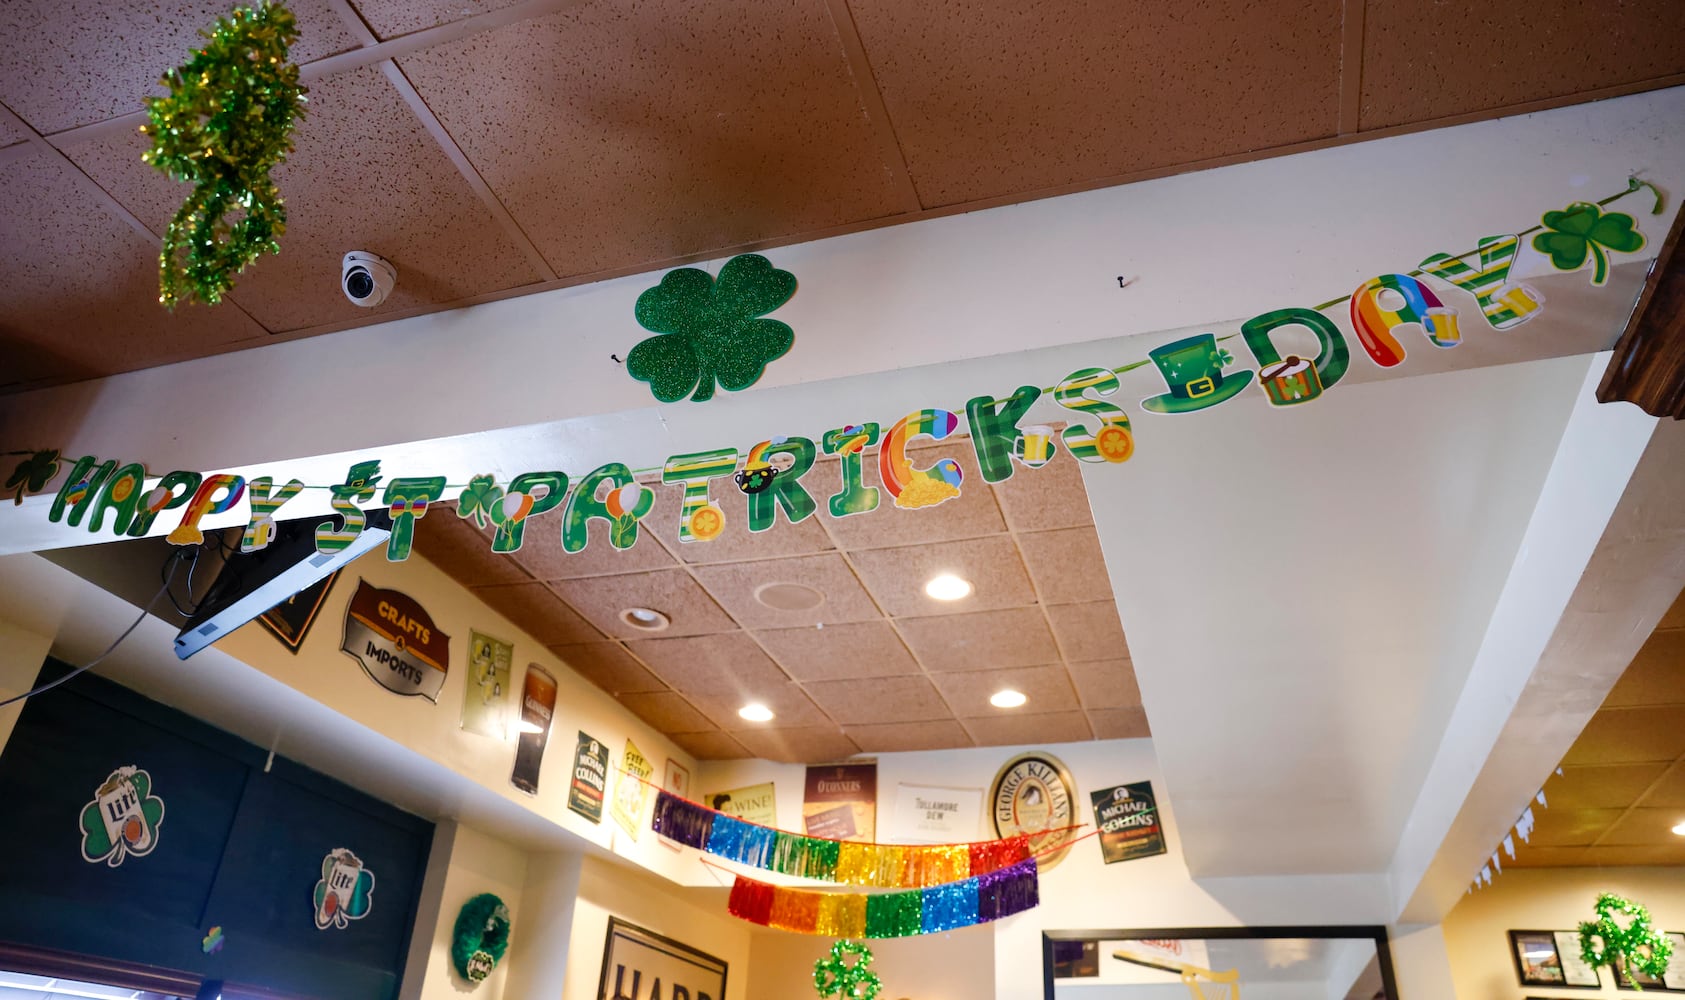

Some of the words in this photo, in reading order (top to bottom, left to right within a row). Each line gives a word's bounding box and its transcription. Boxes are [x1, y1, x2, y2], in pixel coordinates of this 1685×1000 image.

[49, 455, 304, 553] HAPPY
[315, 460, 447, 562] ST
[490, 367, 1135, 554] PATRICKS
[1240, 233, 1524, 407] DAY
[378, 601, 431, 645] CRAFTS
[366, 640, 423, 685] IMPORTS
[579, 754, 604, 776] MICHAEL
[575, 767, 604, 792] COLLINS
[107, 790, 137, 822] Lite
[915, 797, 959, 812] TULLAMORE
[1000, 767, 1025, 822] GEORGE
[926, 811, 944, 820] DEW
[1101, 801, 1147, 820] MICHAEL
[1102, 814, 1153, 833] COLLINS
[330, 869, 354, 889] Lite
